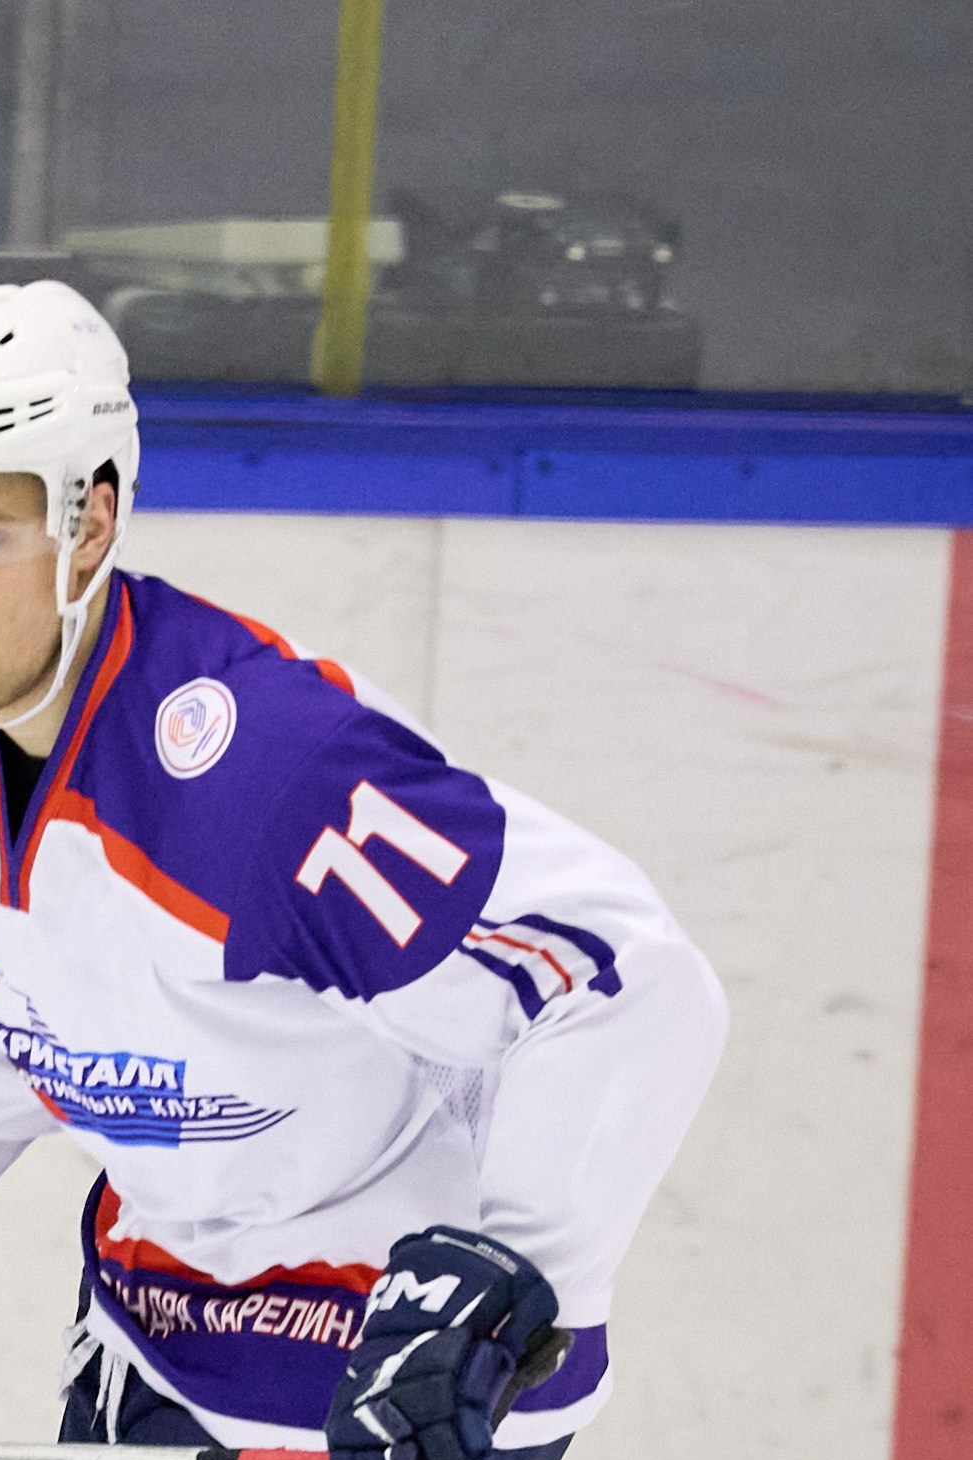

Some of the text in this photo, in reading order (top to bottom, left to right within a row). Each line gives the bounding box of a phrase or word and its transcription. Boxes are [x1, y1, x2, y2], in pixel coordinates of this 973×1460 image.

[295, 779, 471, 949] 71
[148, 1097, 220, 1118] КЛУБ
[203, 1293, 366, 1350] КАРЕЛИН
